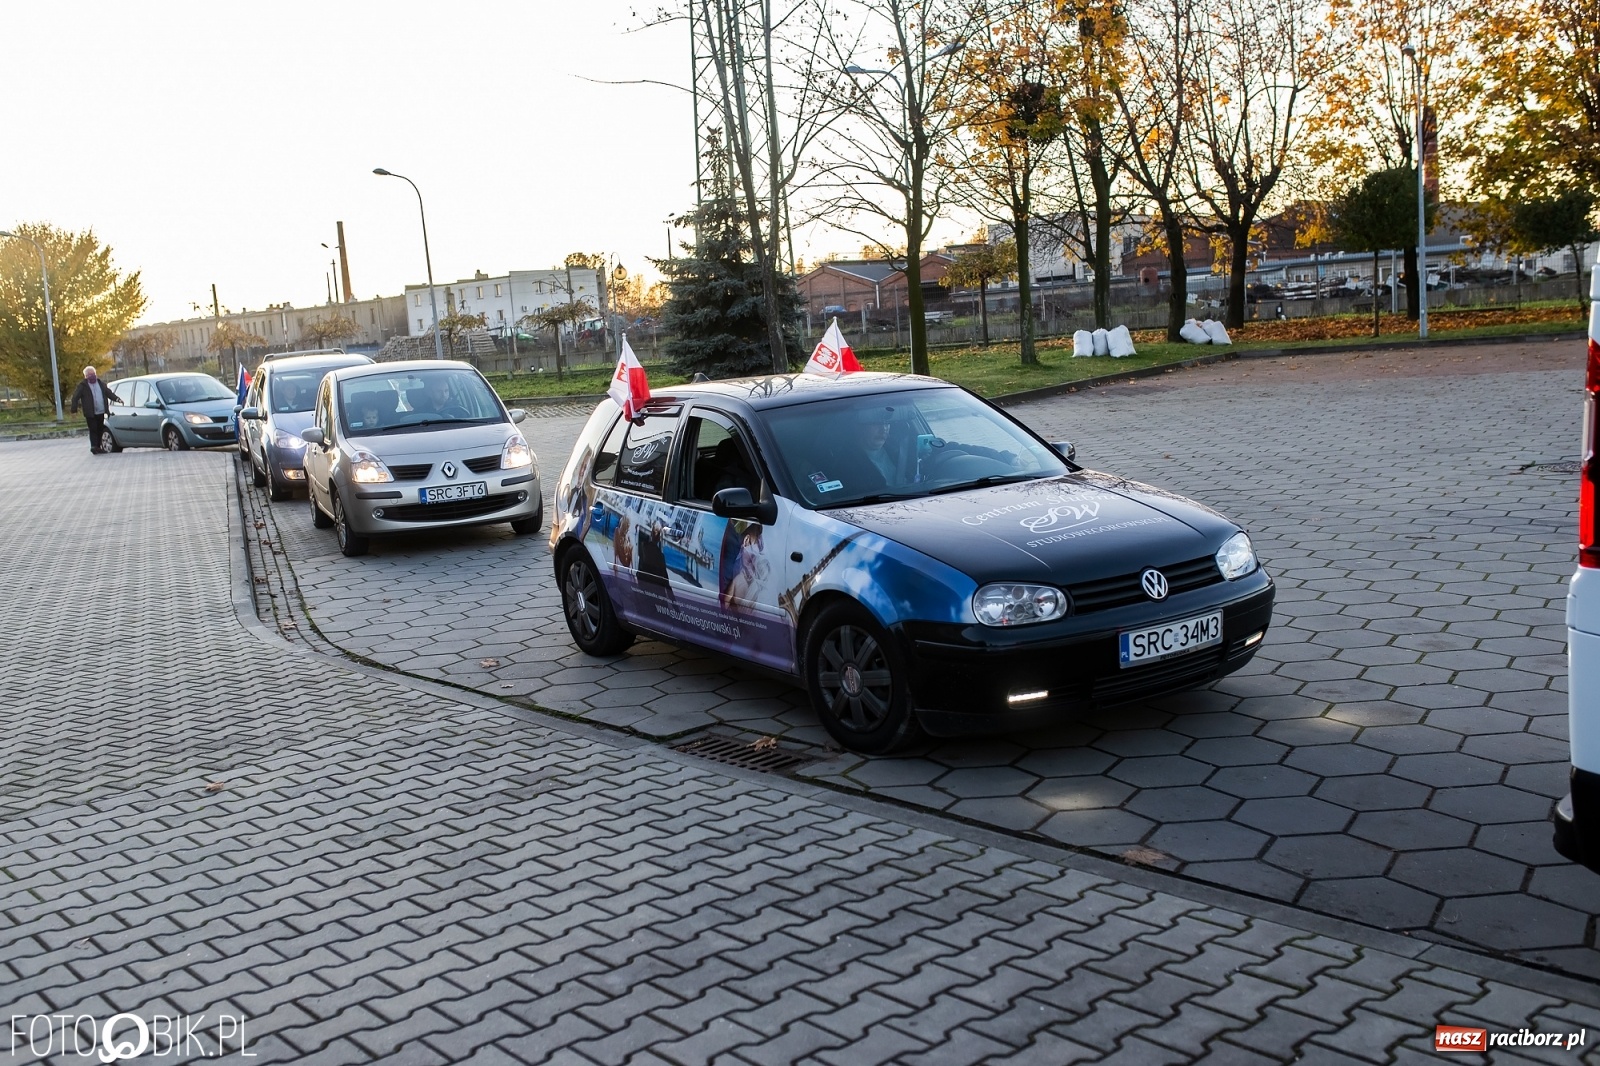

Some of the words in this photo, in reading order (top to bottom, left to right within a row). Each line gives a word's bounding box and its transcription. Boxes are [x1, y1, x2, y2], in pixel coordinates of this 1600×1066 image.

[428, 487, 453, 500] SRC
[456, 483, 484, 498] 3FT6
[961, 500, 1043, 526] Centrum
[1026, 516, 1172, 548] STUDIOWEGOROWSKI.PL
[1132, 627, 1174, 658] SRC
[1179, 616, 1220, 647] 34M3
